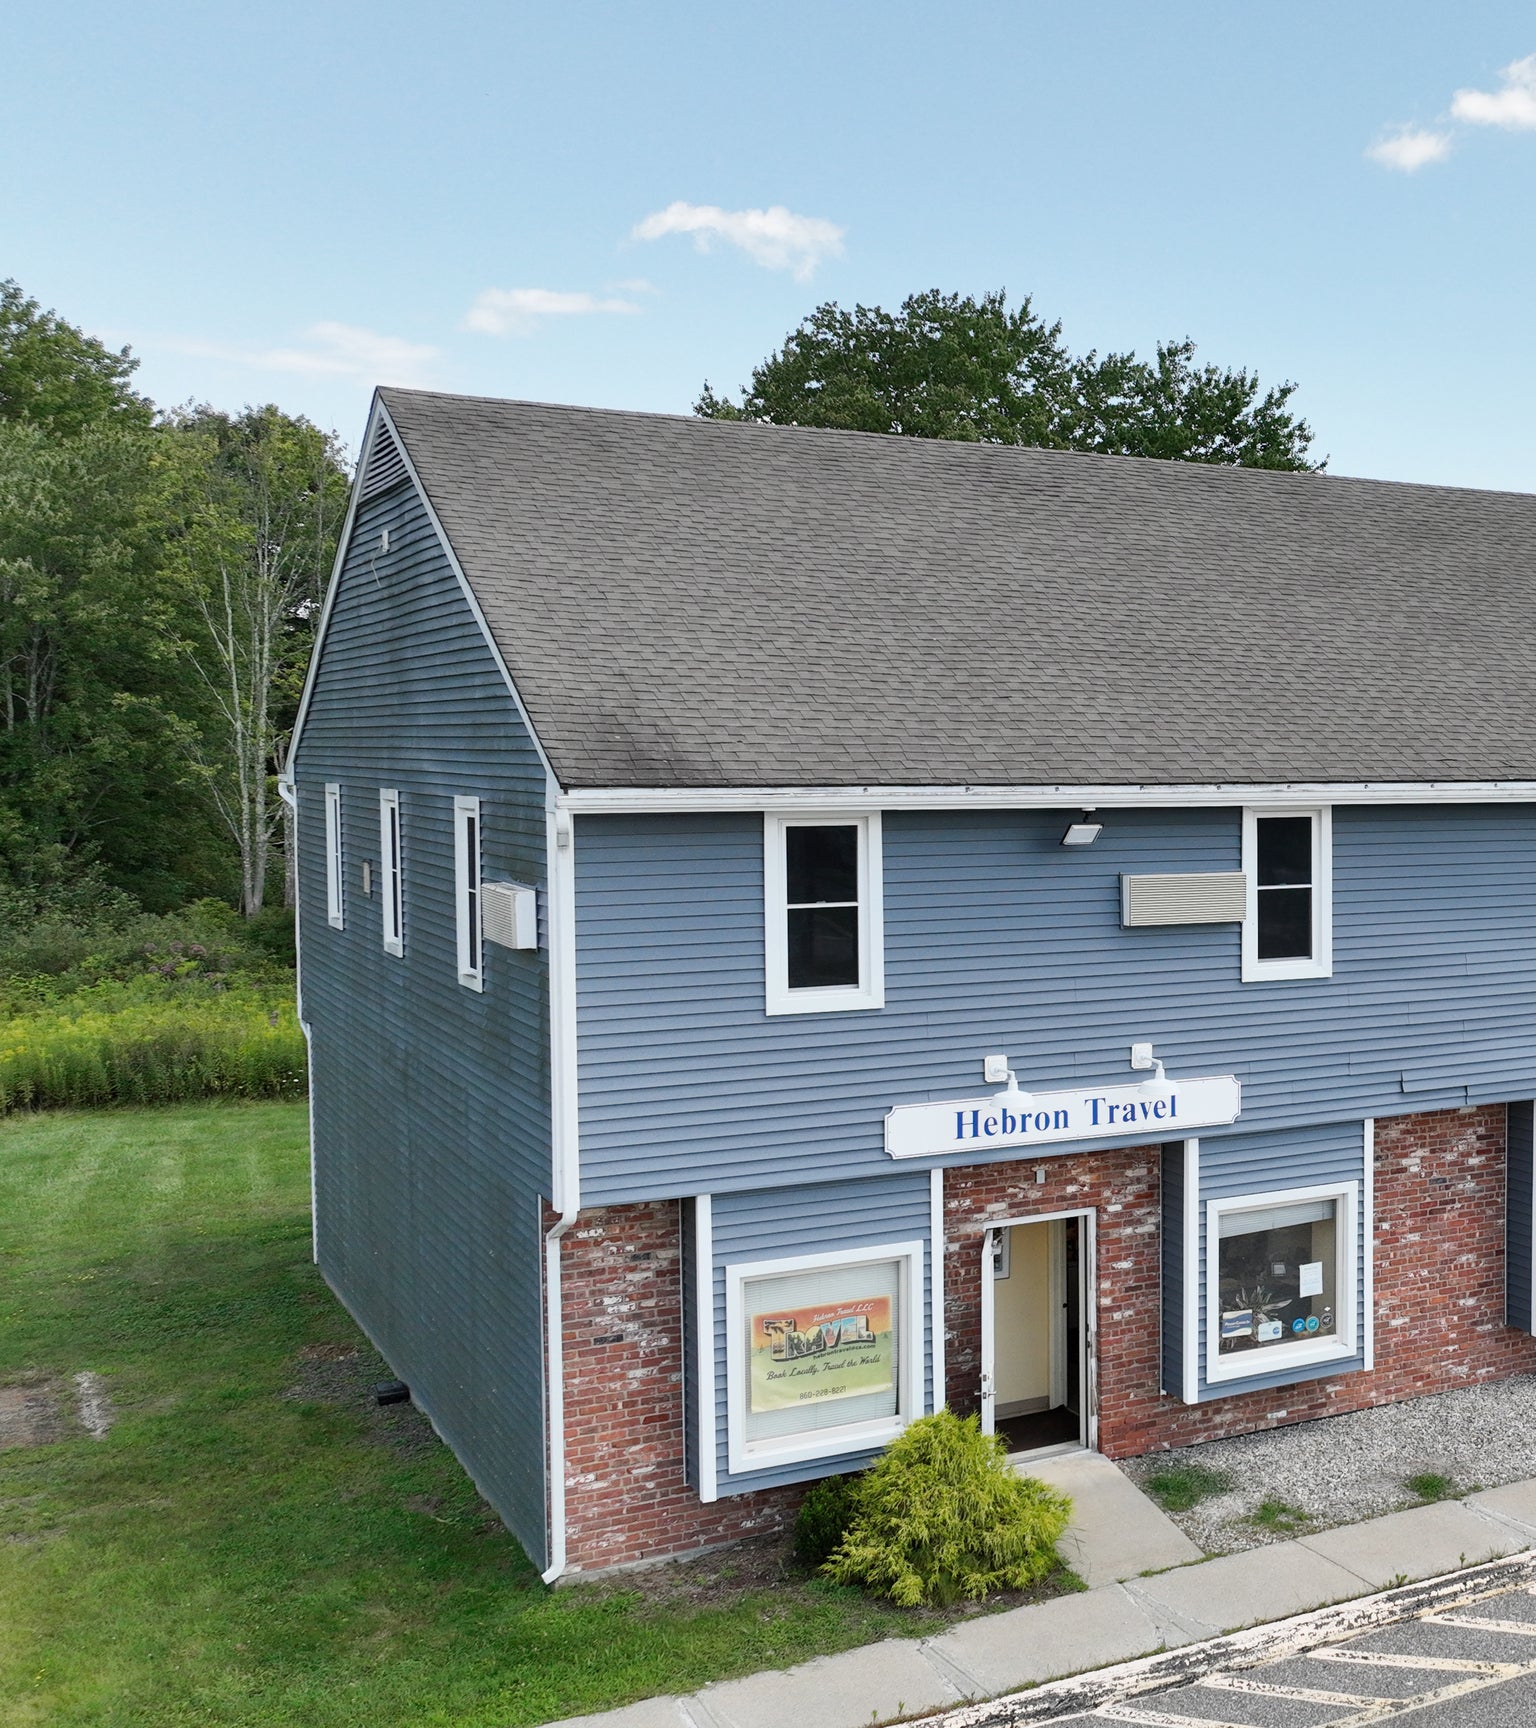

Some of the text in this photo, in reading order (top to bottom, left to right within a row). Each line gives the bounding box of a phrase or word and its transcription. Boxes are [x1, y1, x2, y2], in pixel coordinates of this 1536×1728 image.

[954, 1095, 1178, 1140] Hebron Travel
[856, 1303, 874, 1312] LLC
[762, 1315, 876, 1361] TRAVEL
[766, 1370, 787, 1381] Book
[822, 1361, 845, 1372] Travel
[847, 1359, 859, 1368] the
[859, 1354, 882, 1366] World
